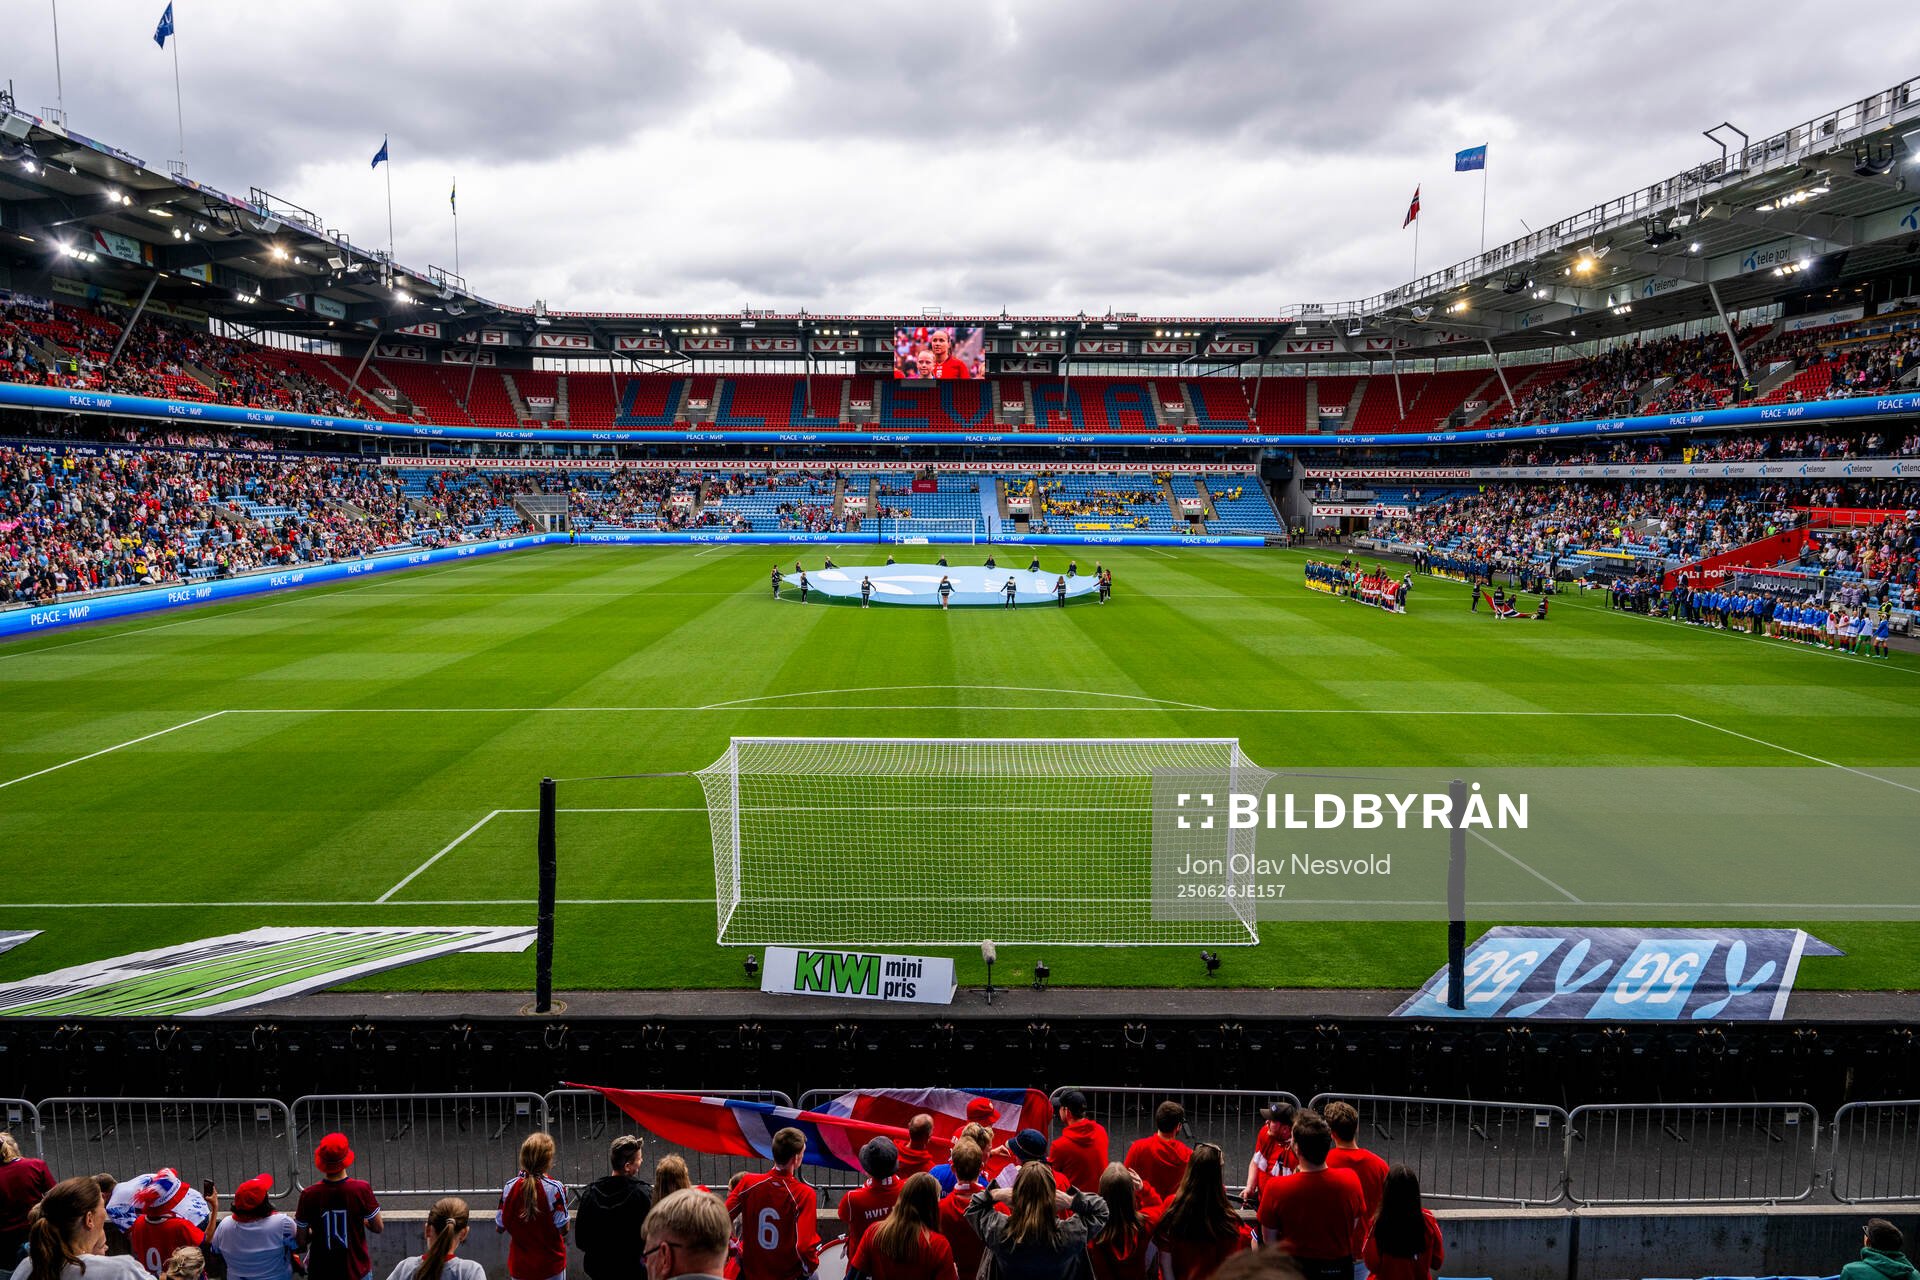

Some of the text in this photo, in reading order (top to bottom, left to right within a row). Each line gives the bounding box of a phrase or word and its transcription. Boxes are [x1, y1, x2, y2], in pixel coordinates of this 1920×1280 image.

[542, 335, 592, 348] VG
[620, 337, 665, 350] VG
[683, 337, 733, 350] VG
[752, 338, 798, 351] VG
[813, 339, 859, 351] VG
[1015, 340, 1063, 352] VG
[1079, 341, 1125, 353] VG
[1146, 341, 1192, 353] VG
[1208, 341, 1254, 354] VG
[1287, 340, 1333, 352] VG
[379, 346, 425, 360] VG
[445, 351, 493, 364] VG
[1004, 360, 1050, 372] VG
[70, 396, 91, 406] PEACE
[529, 397, 554, 405] VG
[1877, 399, 1903, 410] PEACE
[169, 405, 184, 414] PEACE
[1761, 409, 1781, 418] PEACE
[247, 412, 260, 421] PEACE
[1670, 417, 1684, 425] PEACE
[776, 461, 799, 469] VG
[1727, 466, 1745, 474] telenor
[1765, 466, 1783, 474] telenor
[1804, 465, 1826, 473] telenor
[1849, 464, 1872, 473] telenor
[1316, 507, 1406, 516] VG VG VG
[1704, 570, 1725, 578] FOR
[271, 576, 287, 586] PEACE
[168, 592, 190, 603] PEACE
[31, 606, 90, 625] PEACE МИР
[794, 951, 882, 996] KIWI
[885, 957, 923, 979] mini
[1613, 952, 1700, 1004] 5G
[883, 978, 917, 1000] pris
[320, 1209, 348, 1250] 10
[757, 1207, 780, 1250] 6
[146, 1247, 162, 1280] 9
